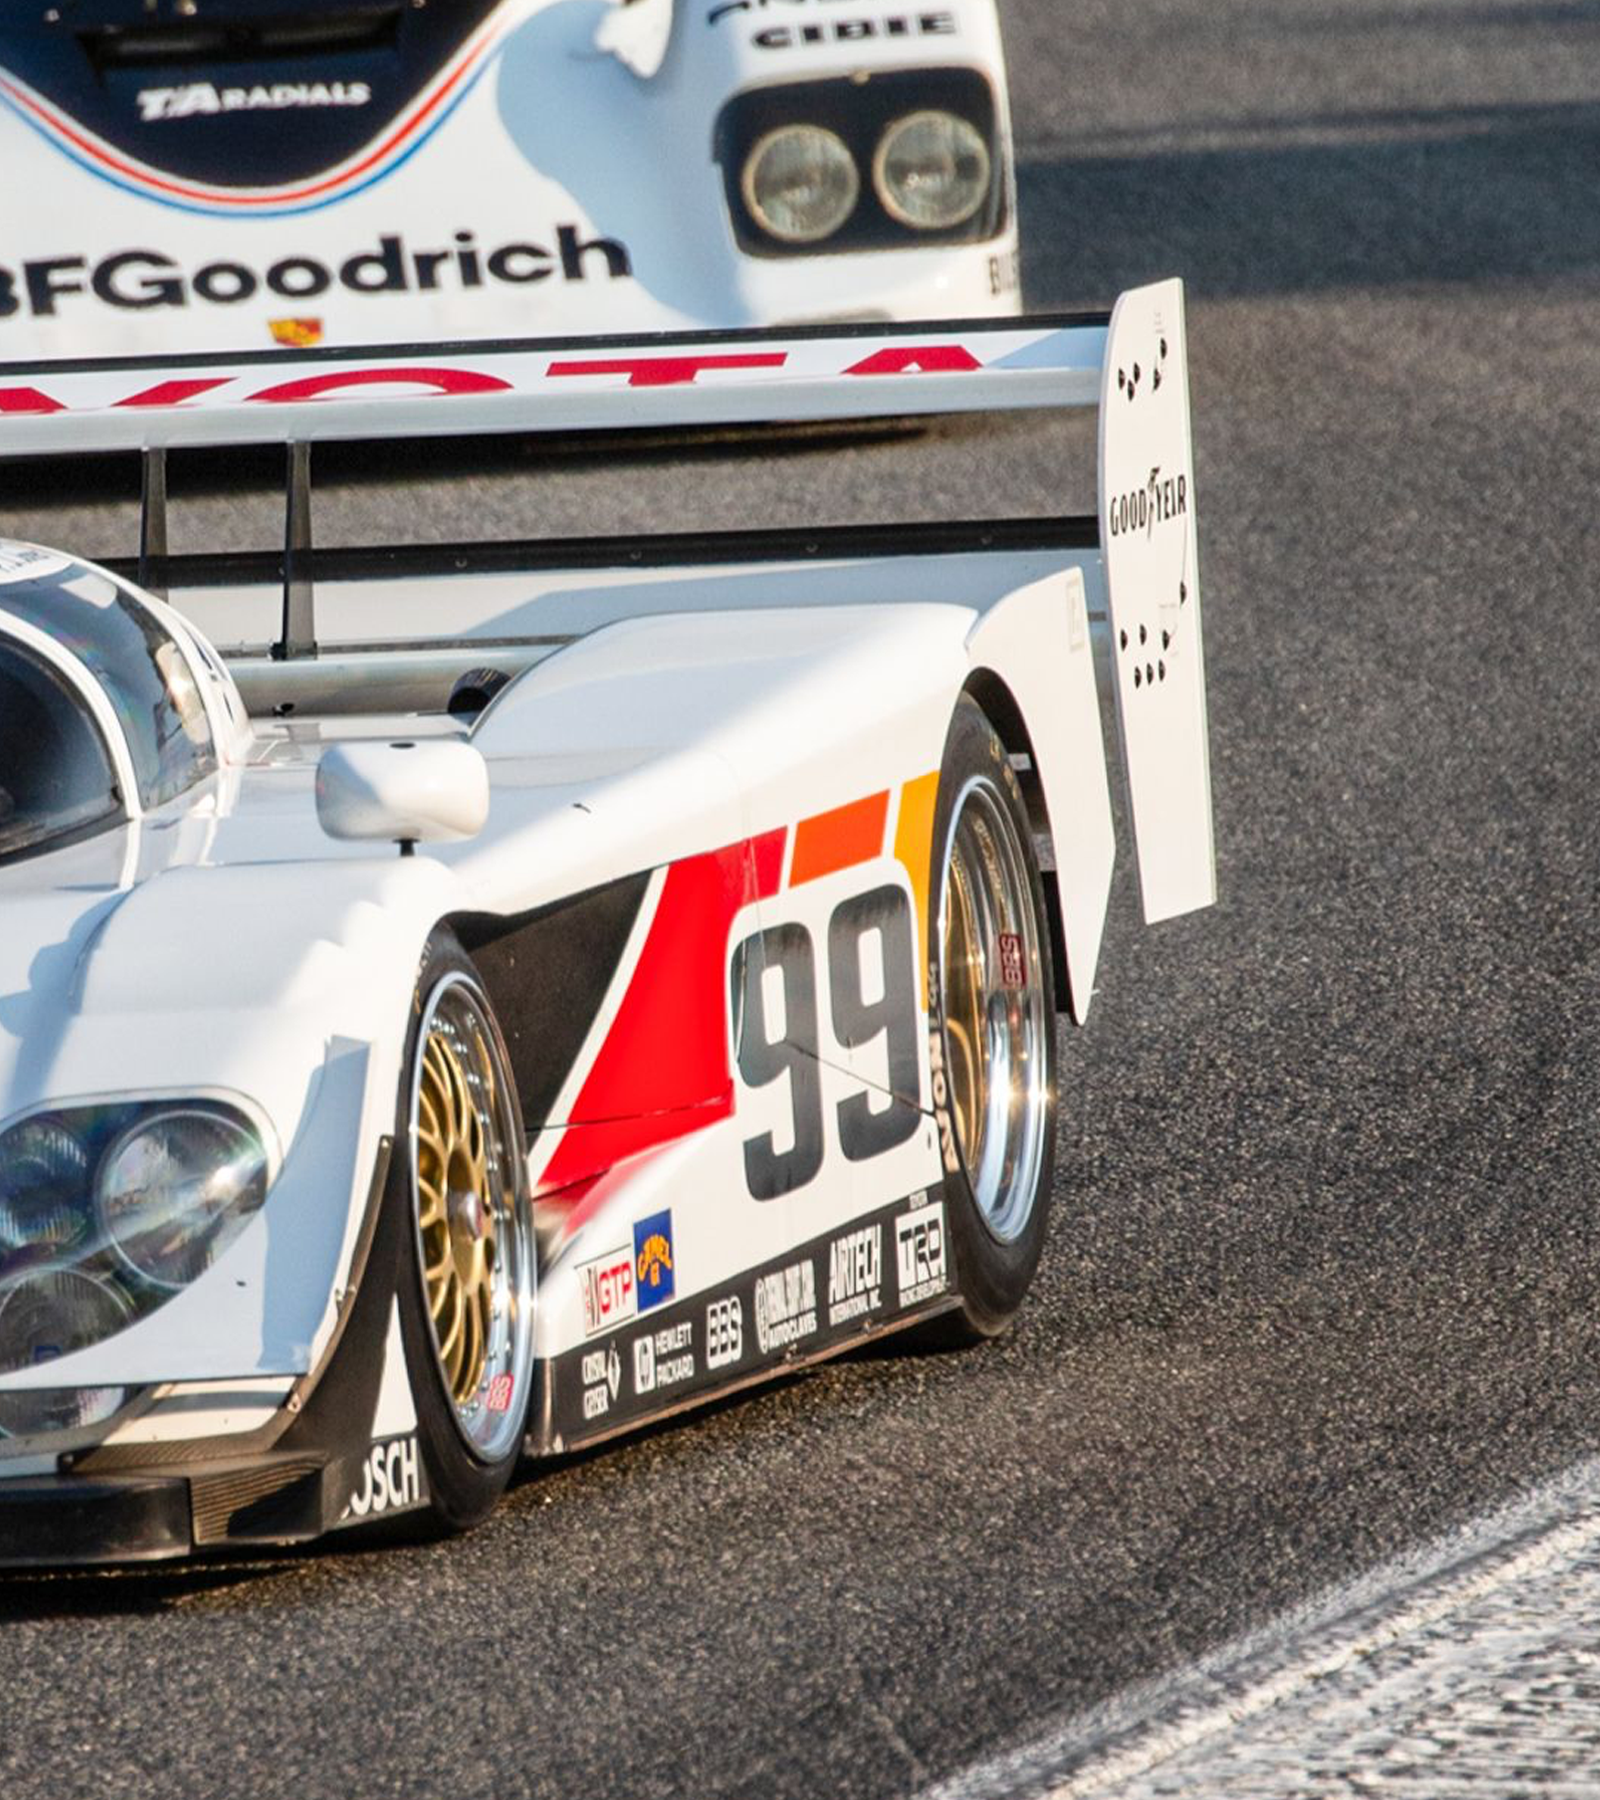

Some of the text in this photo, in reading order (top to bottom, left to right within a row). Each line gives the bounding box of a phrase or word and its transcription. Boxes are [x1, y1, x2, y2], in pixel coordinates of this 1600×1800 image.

[222, 82, 372, 111] RADIALS
[730, 883, 922, 1202] 99
[599, 1260, 633, 1316] GTP
[342, 1437, 420, 1520] SCH
